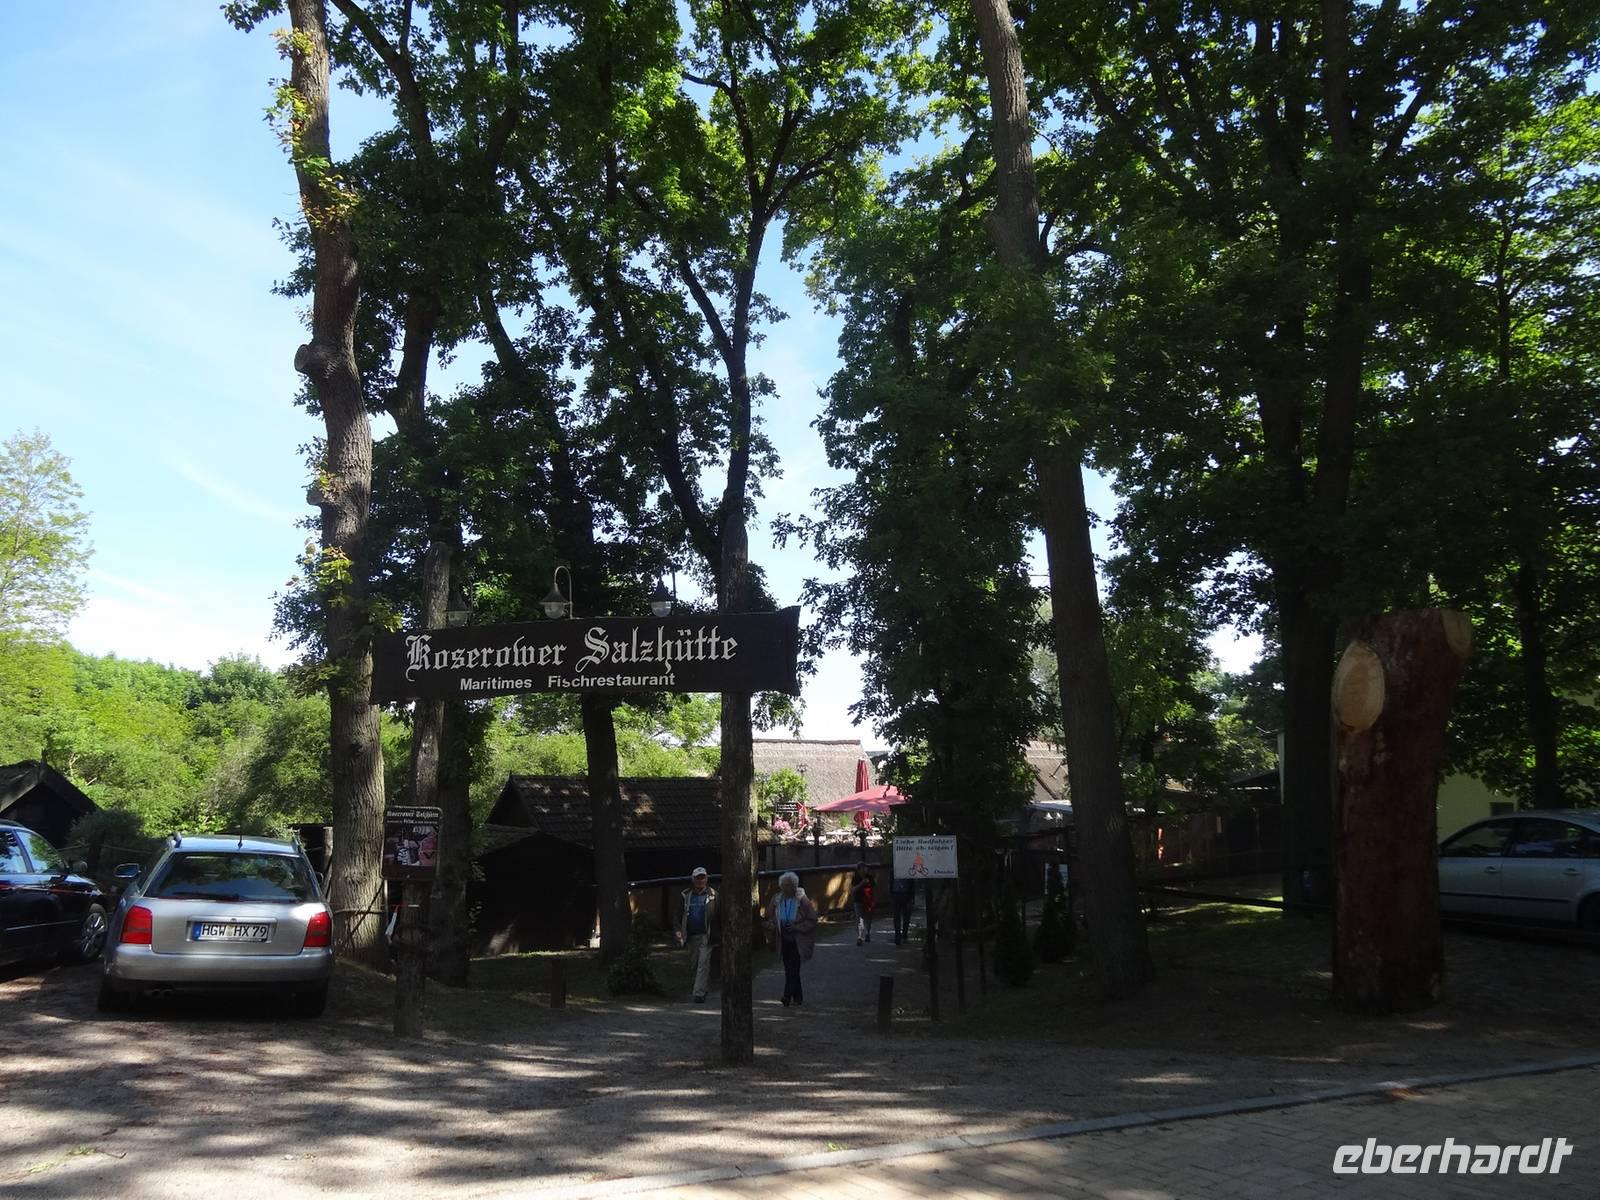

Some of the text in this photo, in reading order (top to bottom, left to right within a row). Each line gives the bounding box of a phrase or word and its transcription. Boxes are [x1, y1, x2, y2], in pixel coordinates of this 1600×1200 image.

[405, 625, 739, 682] Koserower Salzhütte
[460, 673, 676, 691] Maritimes Fischrestaurant
[201, 924, 267, 937] HGW HX 79
